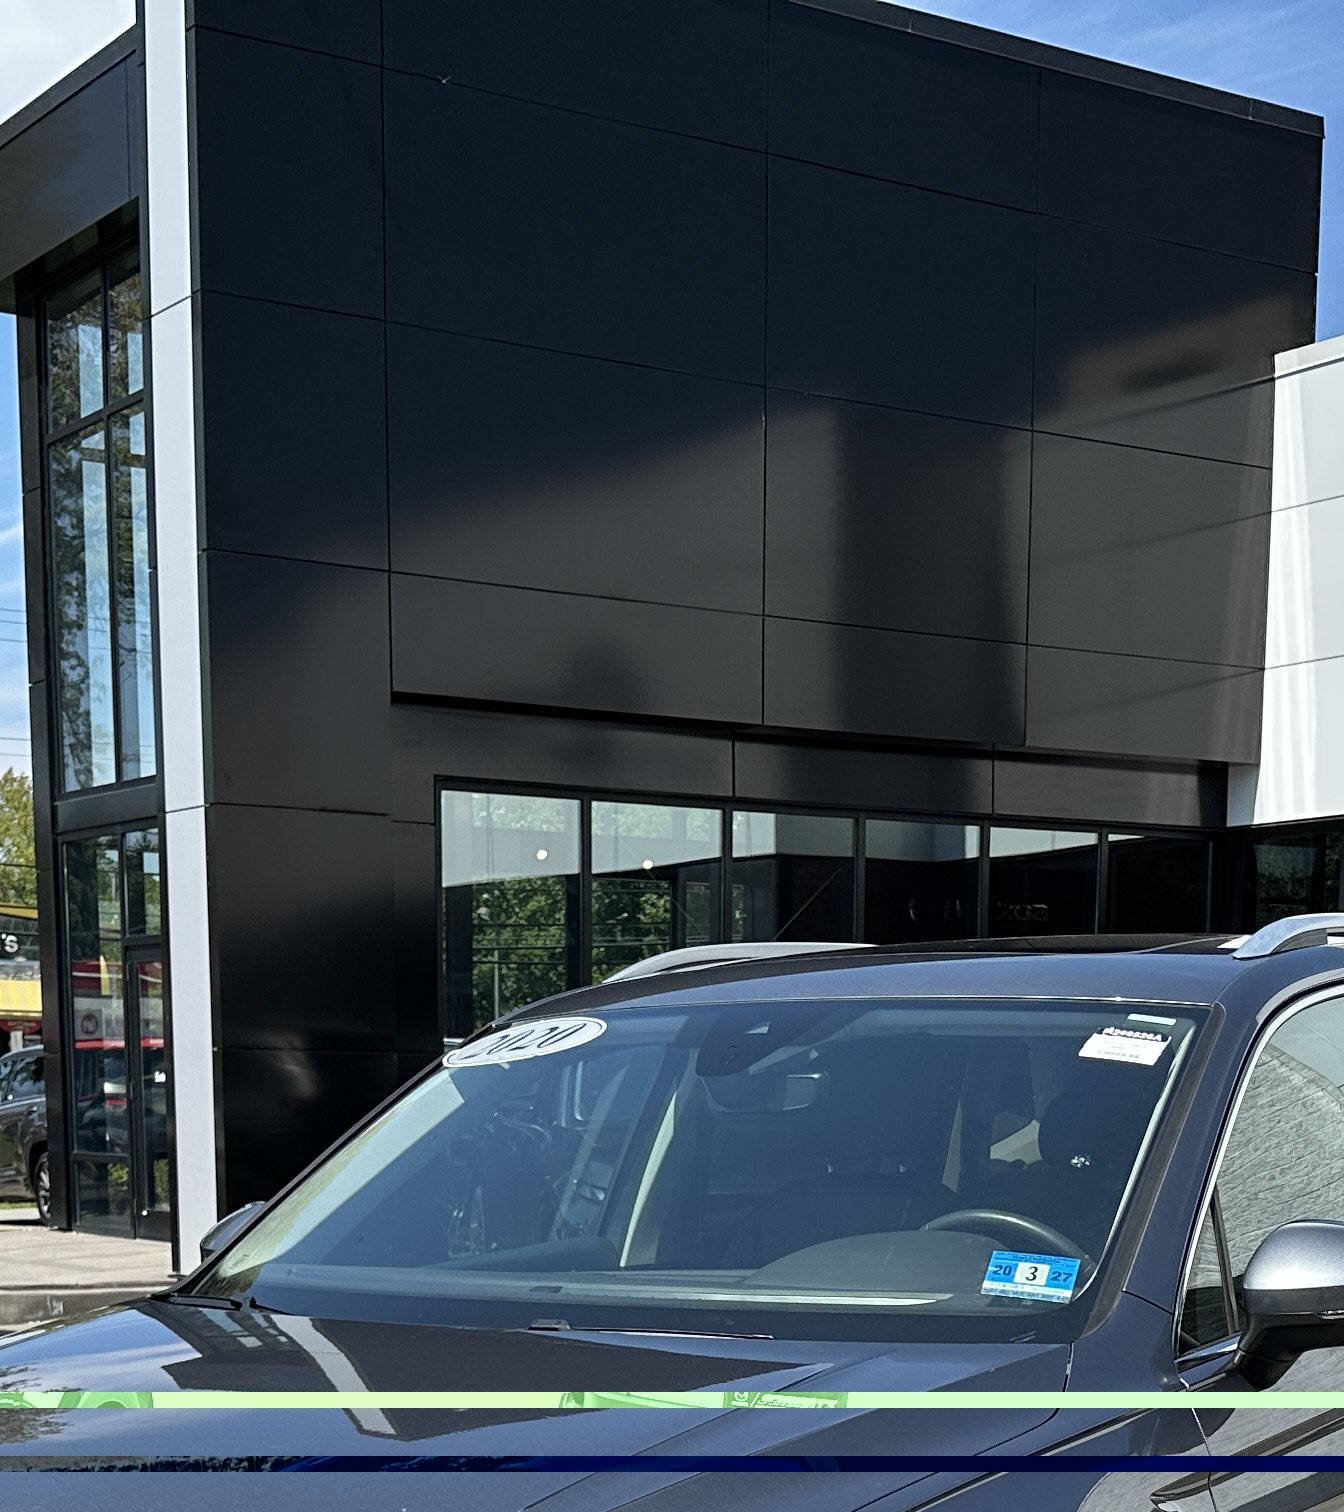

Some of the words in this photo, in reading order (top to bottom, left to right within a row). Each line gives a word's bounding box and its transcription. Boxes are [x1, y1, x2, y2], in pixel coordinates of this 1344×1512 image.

[459, 1023, 587, 1061] 2020
[992, 1264, 1013, 1276] 20
[1025, 1266, 1038, 1281] 3
[1050, 1271, 1073, 1282] 27
